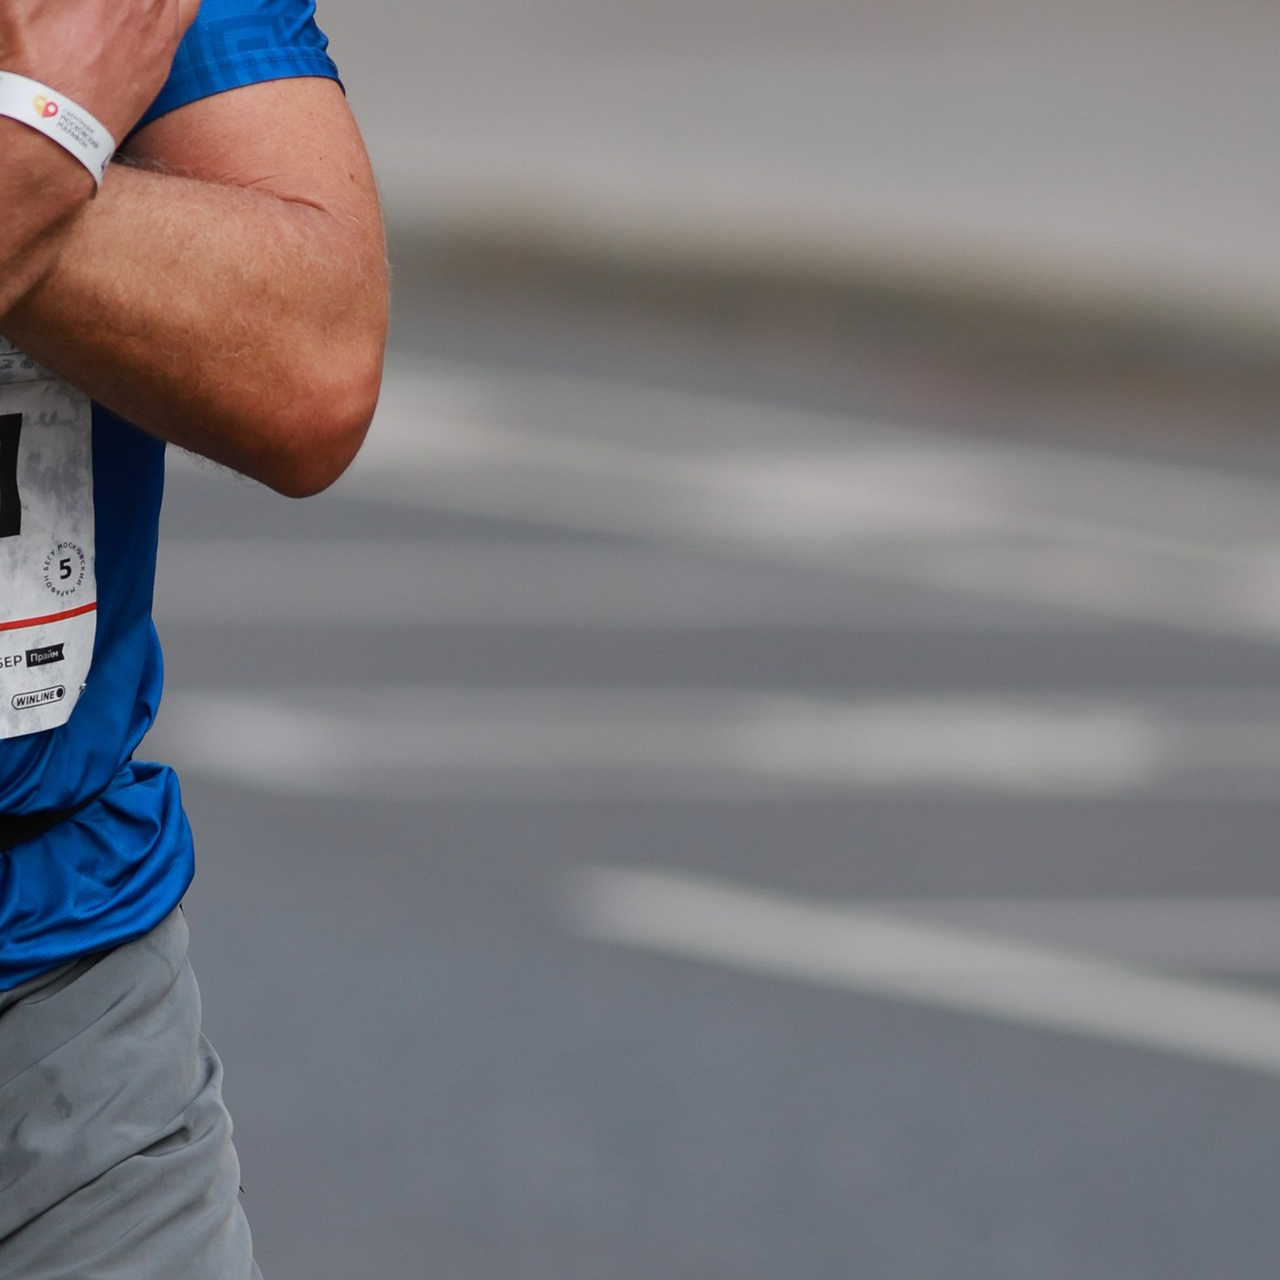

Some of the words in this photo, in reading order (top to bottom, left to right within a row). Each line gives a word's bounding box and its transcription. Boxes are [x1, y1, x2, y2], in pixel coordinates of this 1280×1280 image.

[59, 558, 73, 580] 5
[29, 651, 60, 663] Прайм
[16, 692, 56, 706] WINLINE
